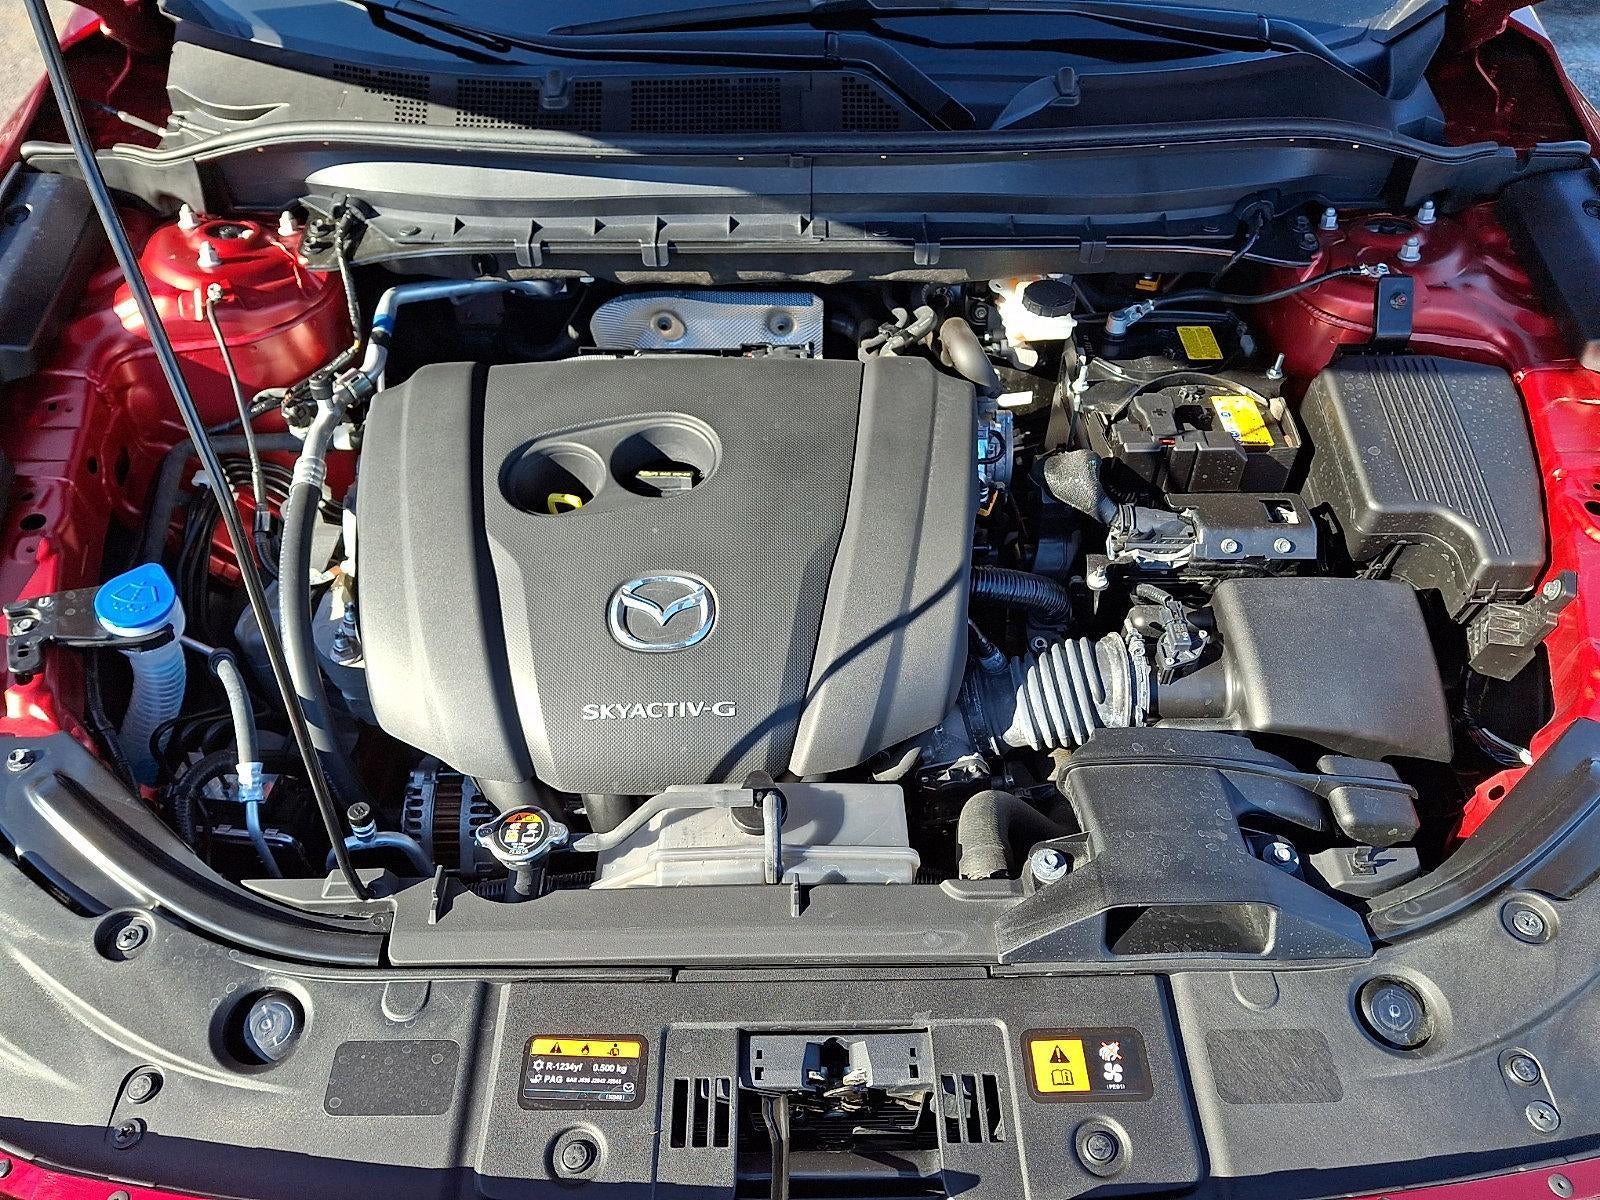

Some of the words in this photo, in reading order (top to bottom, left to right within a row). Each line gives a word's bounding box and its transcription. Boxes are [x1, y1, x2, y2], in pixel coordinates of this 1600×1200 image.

[582, 701, 737, 720] SKYACTIV-G
[546, 1062, 583, 1073] R-1234yf
[592, 1063, 615, 1073] 0.500
[616, 1063, 628, 1075] kg
[543, 1075, 563, 1084] PAG
